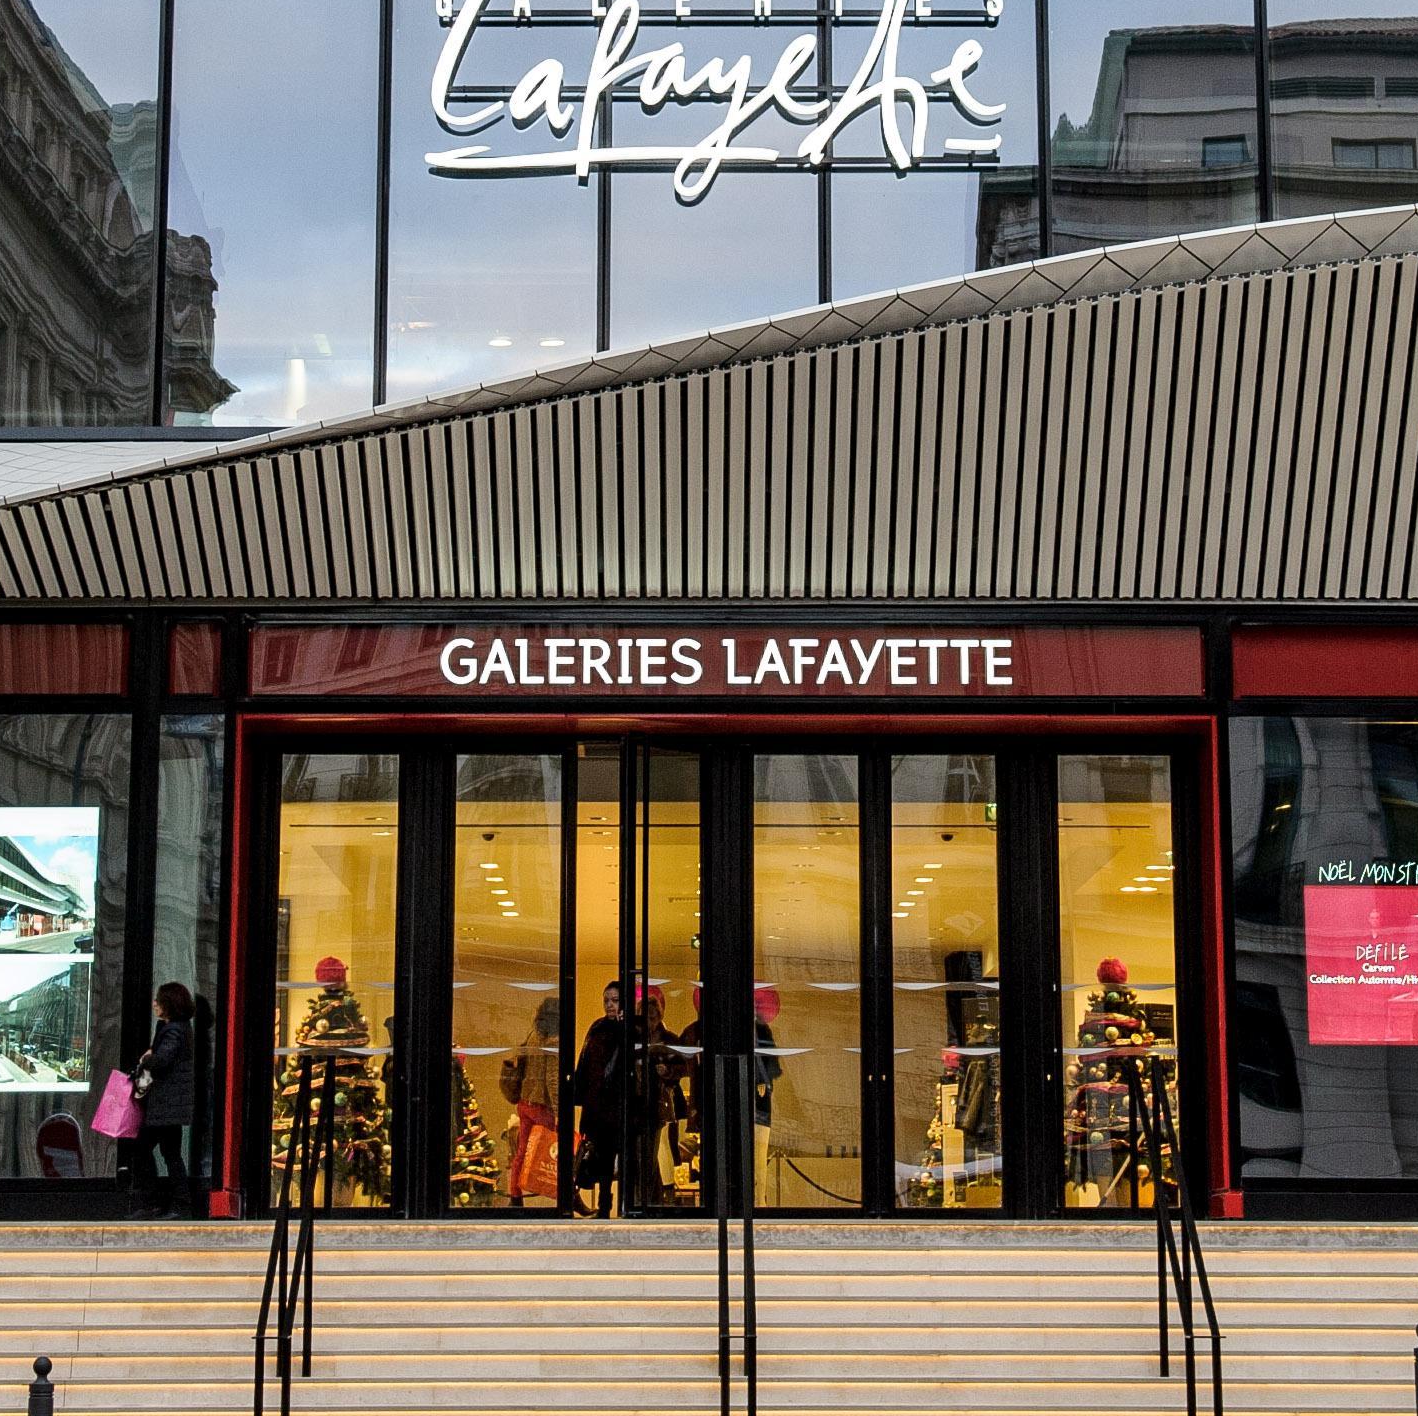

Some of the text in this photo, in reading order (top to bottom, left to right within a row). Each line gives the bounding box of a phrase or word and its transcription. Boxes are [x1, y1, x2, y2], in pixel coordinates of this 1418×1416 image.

[440, 638, 1013, 685] GALERIES LAFAYETTE
[1318, 859, 1356, 883] NOËL
[1361, 963, 1395, 973] Carven
[1309, 974, 1356, 985] Collection
